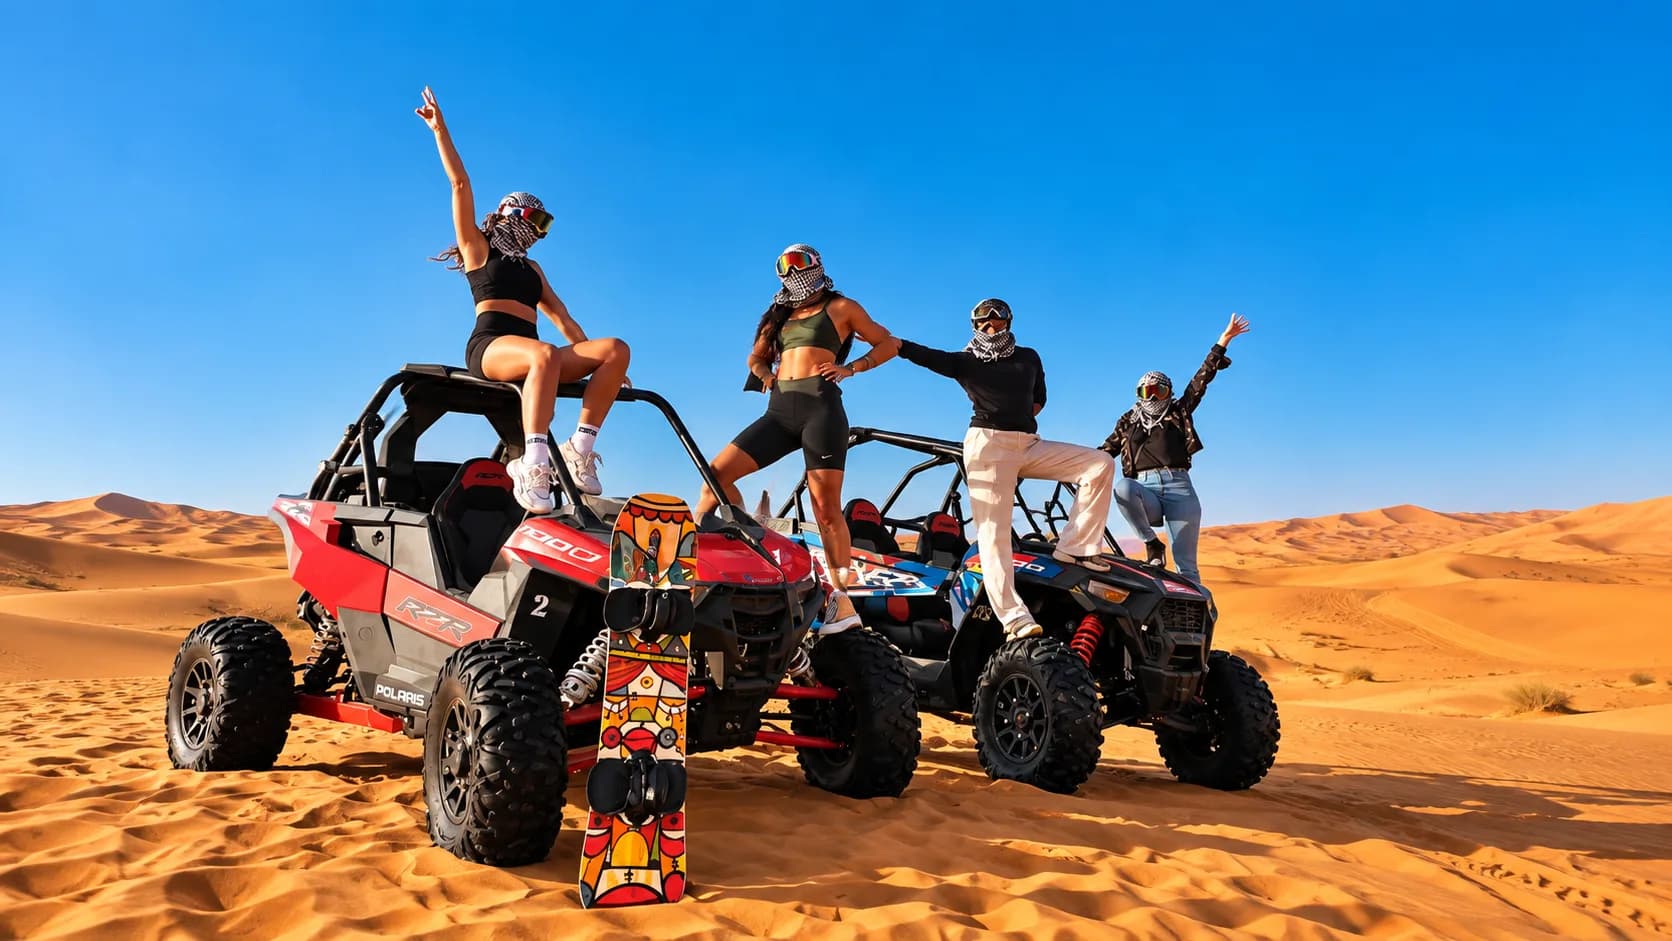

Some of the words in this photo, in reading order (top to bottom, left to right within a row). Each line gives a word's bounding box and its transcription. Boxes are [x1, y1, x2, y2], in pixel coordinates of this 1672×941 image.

[530, 595, 549, 618] 2
[395, 596, 473, 642] RZR
[376, 684, 425, 707] POLARIS
